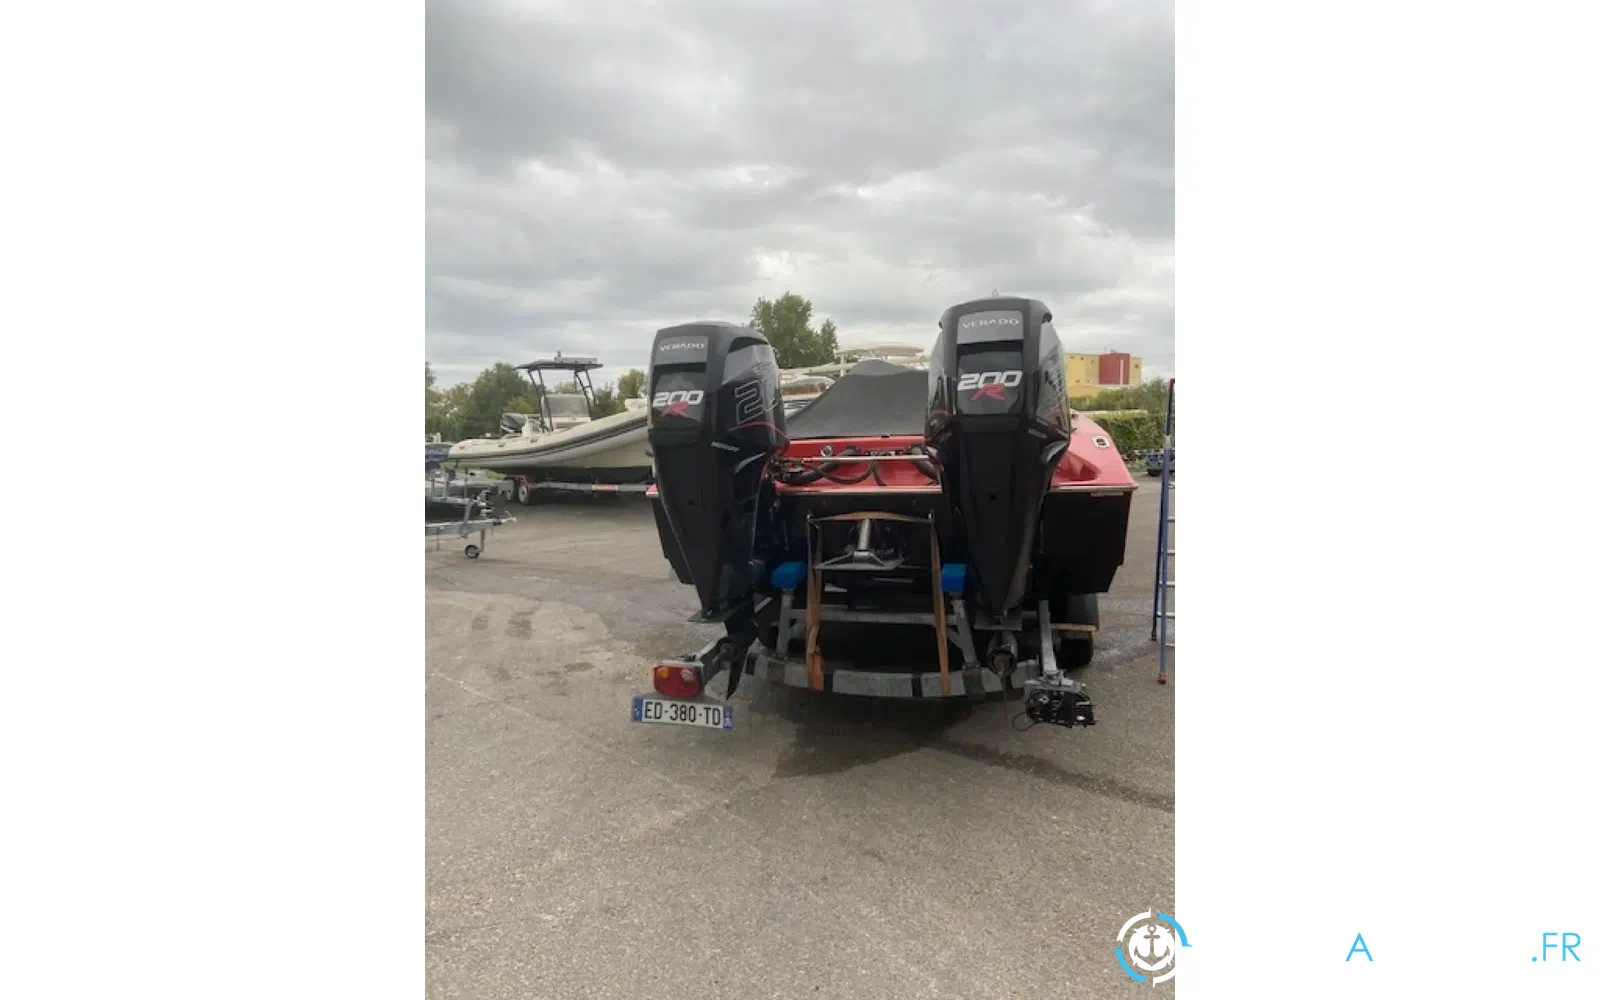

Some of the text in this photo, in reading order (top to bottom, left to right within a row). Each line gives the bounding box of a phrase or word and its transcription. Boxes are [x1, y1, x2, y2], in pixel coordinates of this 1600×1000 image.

[961, 318, 1020, 329] VERADO
[660, 341, 706, 352] VERADO
[957, 370, 1023, 392] 200
[652, 390, 704, 407] 200
[644, 701, 721, 726] ED-380-TD
